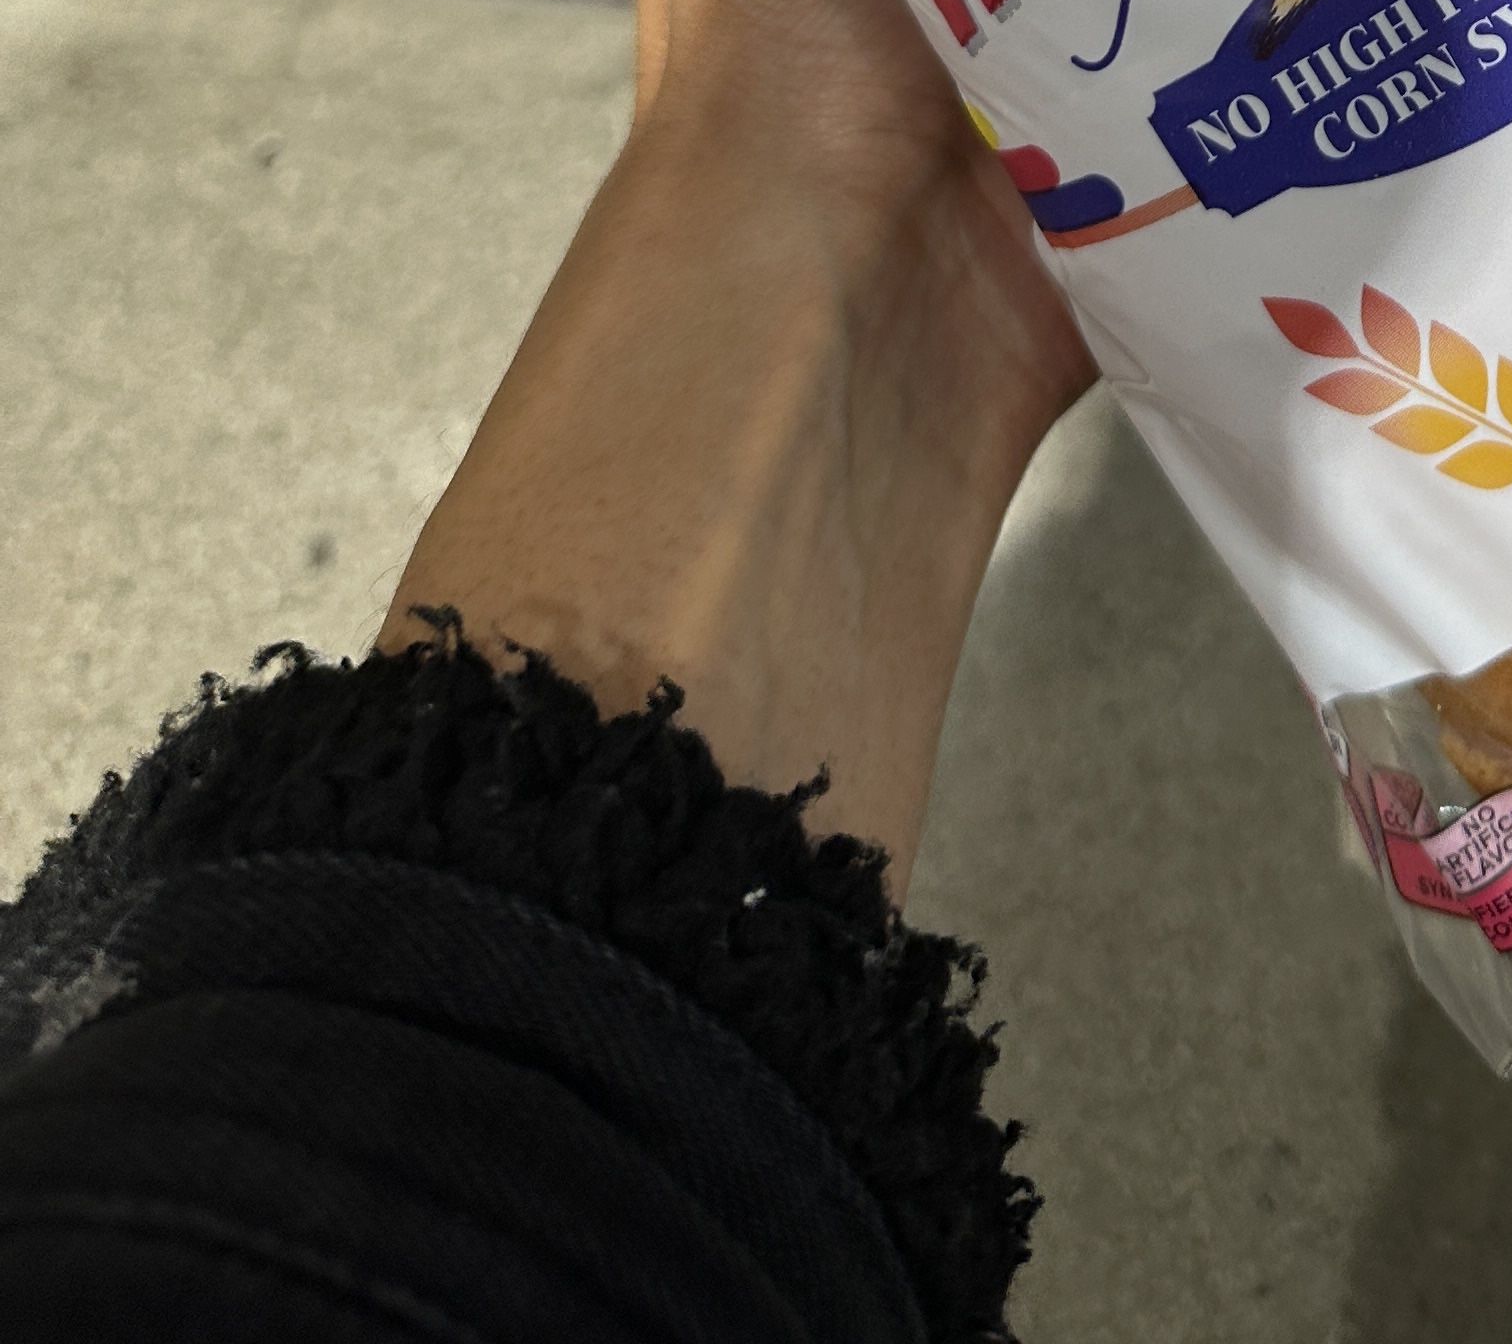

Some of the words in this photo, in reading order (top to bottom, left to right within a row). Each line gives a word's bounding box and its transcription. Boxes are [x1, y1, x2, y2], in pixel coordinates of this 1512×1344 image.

[1186, 93, 1270, 163] NO
[1313, 45, 1465, 159] CORN
[1461, 806, 1495, 837] NO
